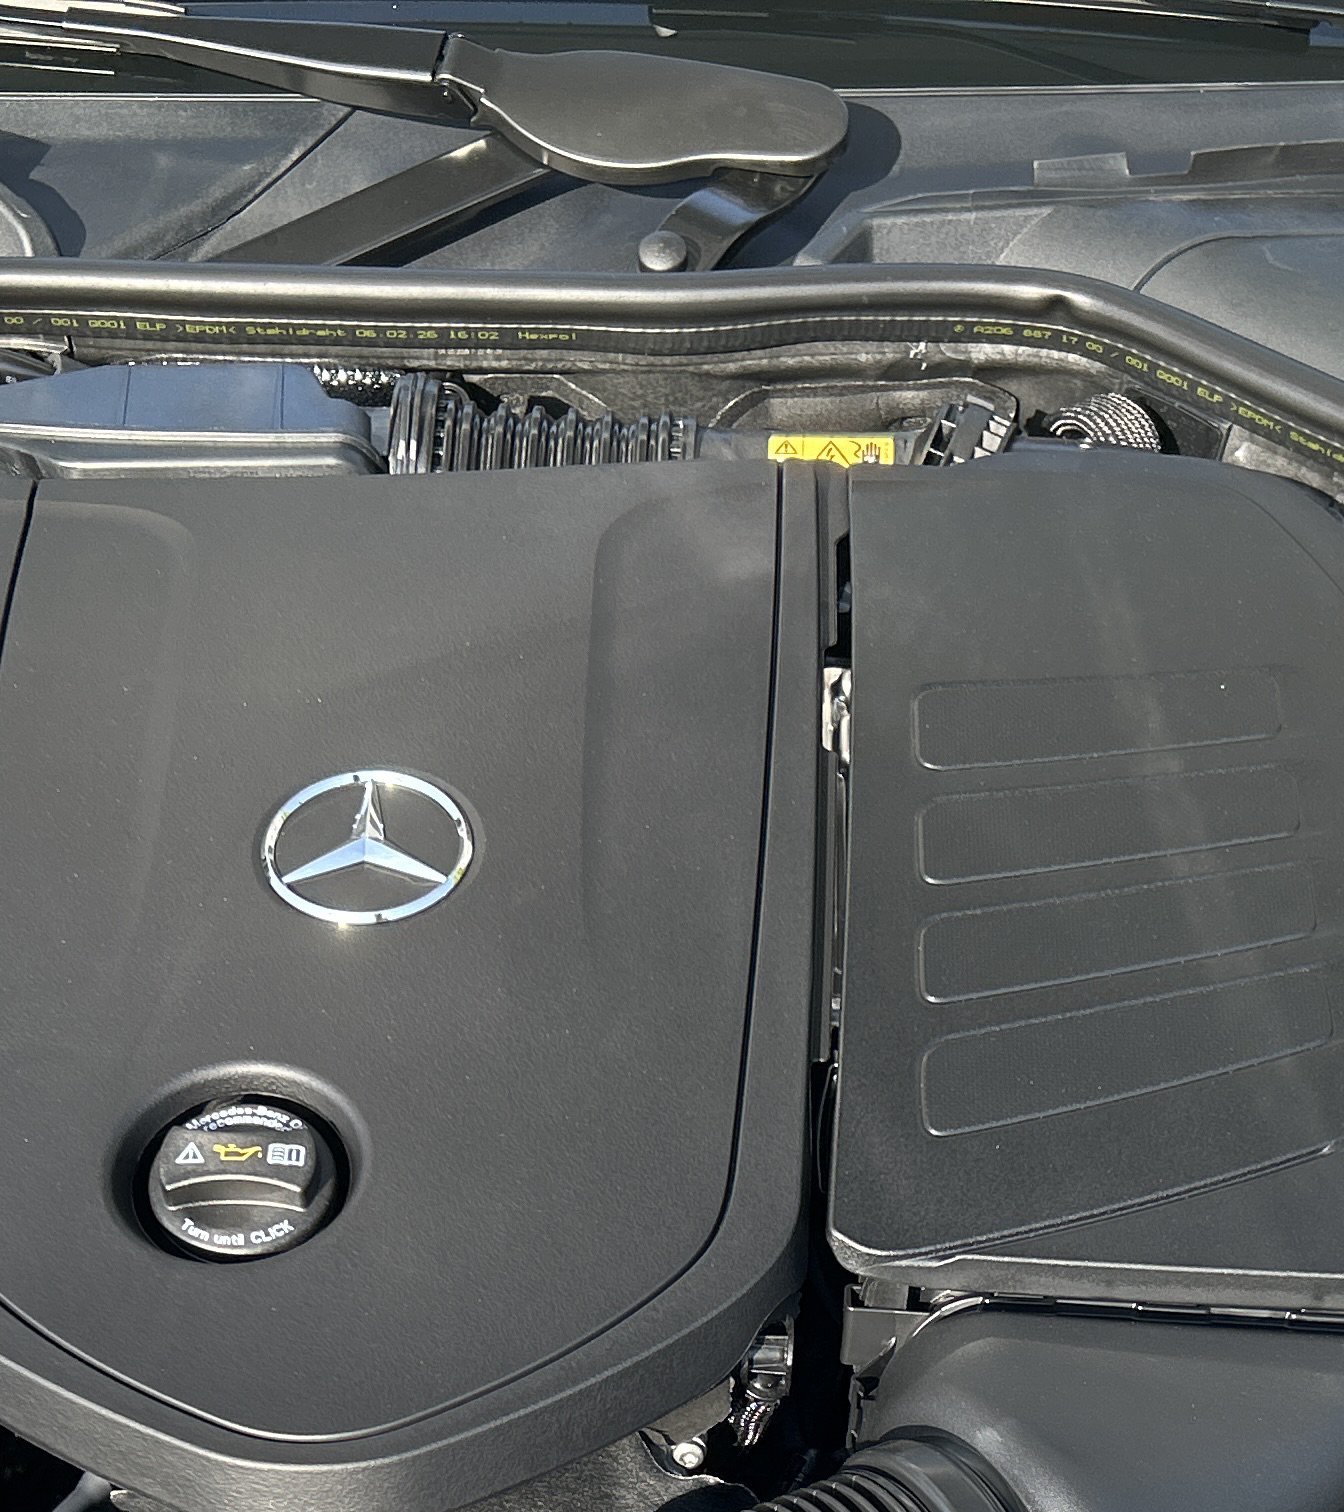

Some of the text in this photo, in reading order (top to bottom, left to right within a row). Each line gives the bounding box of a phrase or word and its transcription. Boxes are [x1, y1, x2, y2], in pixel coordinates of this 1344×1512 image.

[136, 322, 166, 332] ELP
[245, 325, 347, 337] Stahldraht
[518, 330, 578, 342] Hexpol
[181, 1217, 295, 1246] Turn until CLICK
